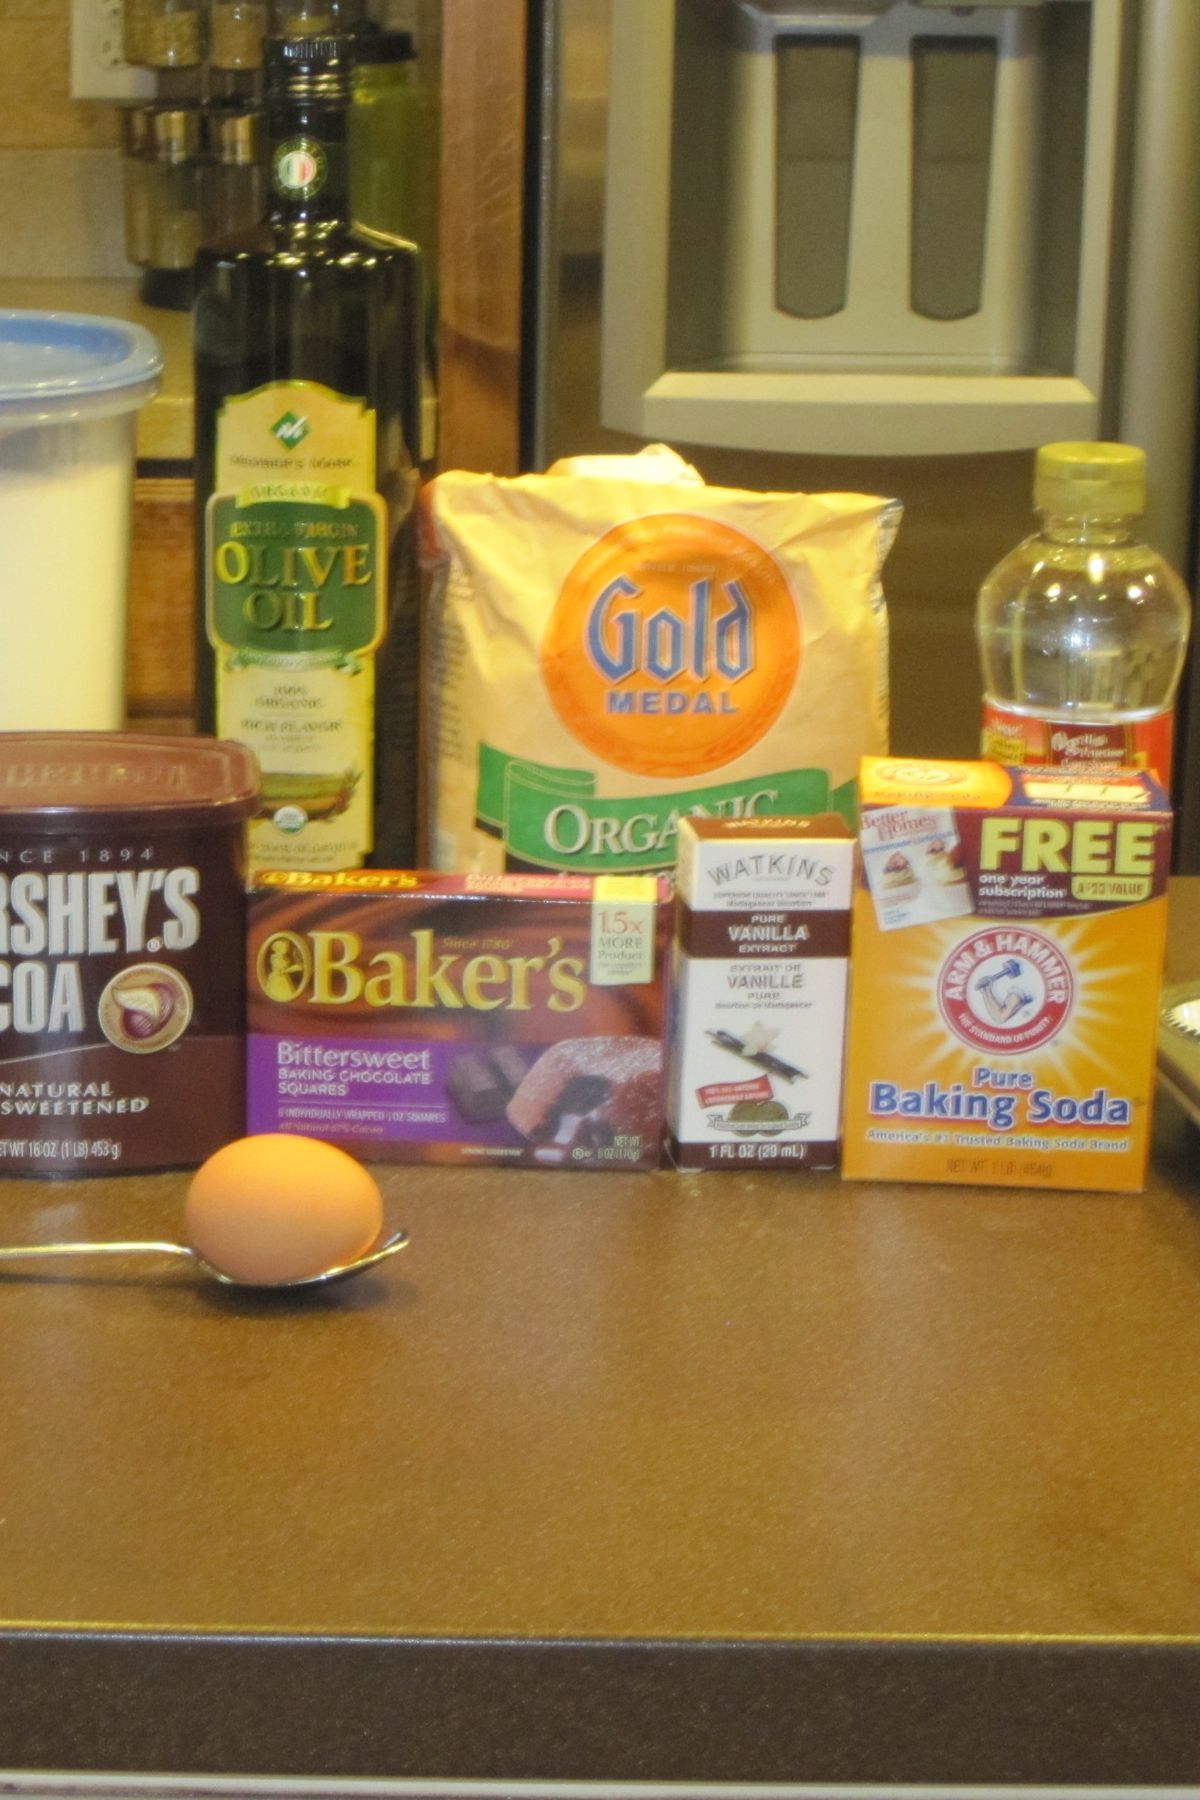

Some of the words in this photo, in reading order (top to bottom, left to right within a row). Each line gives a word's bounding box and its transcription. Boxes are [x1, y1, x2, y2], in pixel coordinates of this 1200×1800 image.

[215, 540, 373, 588] OLIVE
[243, 590, 334, 630] OIL
[585, 574, 755, 685] Gold
[607, 690, 739, 715] MEDAL
[979, 817, 1157, 875] FREE
[79, 848, 155, 863] 1894
[707, 853, 835, 887] WATKINS
[978, 873, 1006, 884] one
[1010, 874, 1045, 888] year
[1109, 882, 1144, 896] VALUE
[978, 885, 1066, 900] subscription
[751, 914, 786, 923] PURE
[600, 936, 643, 948] MORE
[728, 924, 811, 942] VANILLA
[599, 950, 644, 961] Product
[738, 943, 798, 953] EXTRACT
[307, 928, 589, 1013] Baker's
[945, 951, 976, 1002] ARM
[995, 933, 1067, 1004] HAMMER
[727, 974, 804, 989] VANILLE
[747, 992, 781, 1001] PURE
[277, 1040, 432, 1070] Bittersweet
[278, 1068, 335, 1082] BAKING
[339, 1069, 432, 1085] CHOCOLATE
[973, 1067, 1033, 1088] Pure
[277, 1082, 347, 1097] SQUARES
[870, 1082, 1016, 1130] Baking
[1027, 1088, 1131, 1124] Soda
[9, 1139, 26, 1157] WT
[28, 1139, 41, 1157] 16
[43, 1140, 57, 1158] OZ
[866, 1128, 930, 1143] America's
[955, 1133, 1001, 1146] Trusted
[1006, 1135, 1050, 1150] Baking
[1054, 1137, 1085, 1149] Soda
[1089, 1139, 1129, 1151] Brand
[720, 1145, 735, 1158] FL
[738, 1145, 757, 1159] OZ
